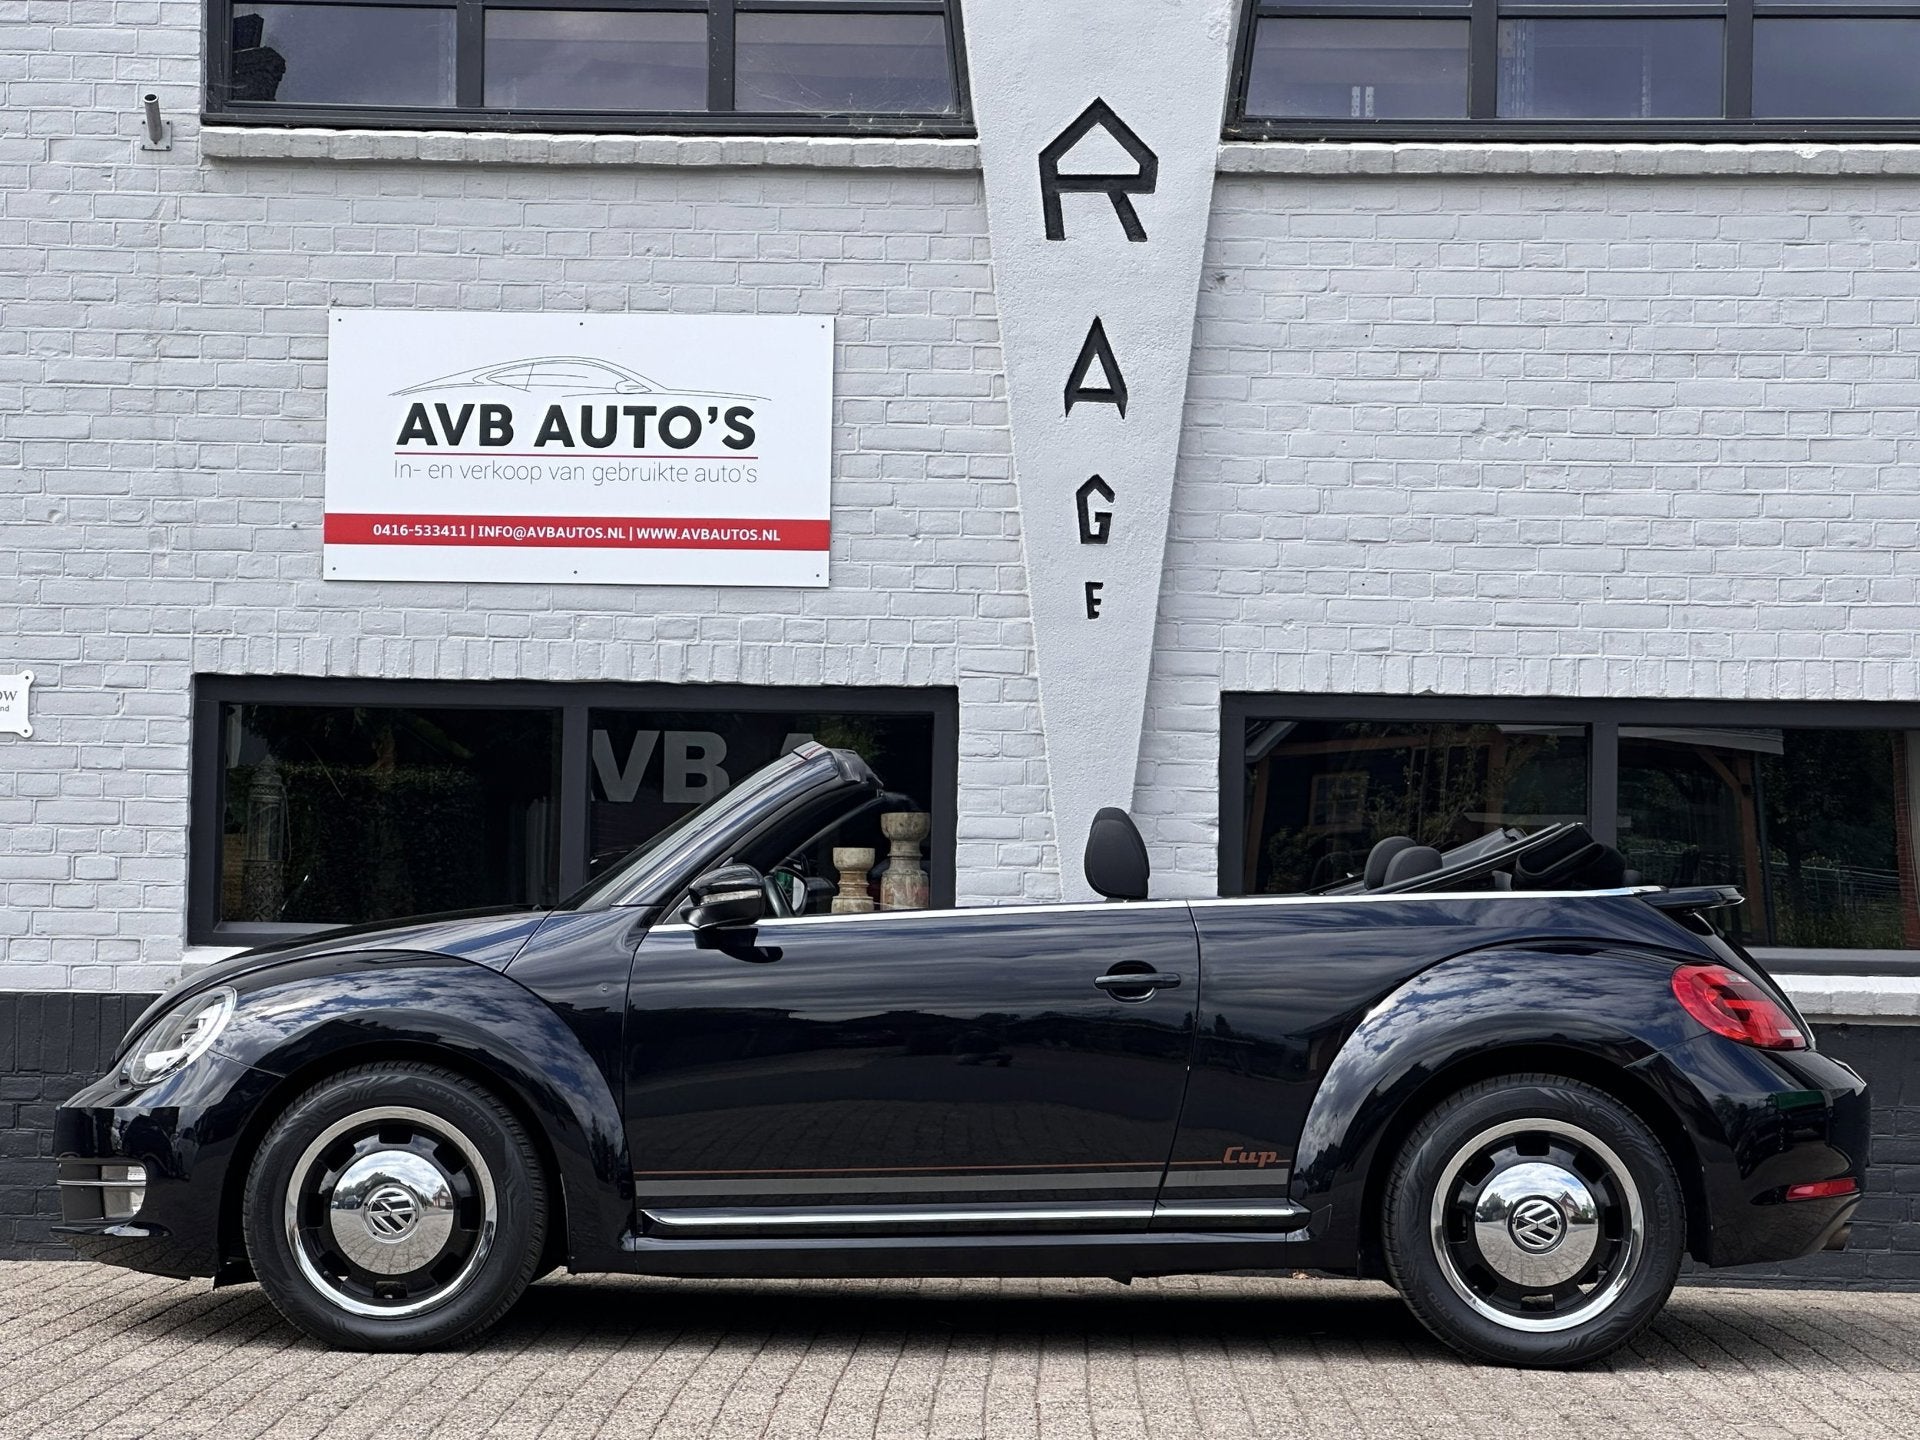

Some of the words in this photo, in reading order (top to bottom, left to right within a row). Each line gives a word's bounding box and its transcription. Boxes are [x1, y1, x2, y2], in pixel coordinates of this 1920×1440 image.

[396, 402, 514, 447] AVB
[533, 405, 756, 450] AUTO'S
[394, 460, 422, 479] In-
[427, 464, 453, 479] en
[459, 460, 542, 484] verkoop
[549, 466, 585, 480] van
[592, 462, 688, 486] gebruikte
[694, 464, 758, 483] auto's
[373, 524, 467, 537] 0416-533411
[478, 525, 626, 541] INFO@AVBAUTOS.NL
[636, 527, 781, 542] WWW.AVBAUTOS.NL
[591, 729, 730, 803] VB
[1223, 1146, 1277, 1168] Cup
